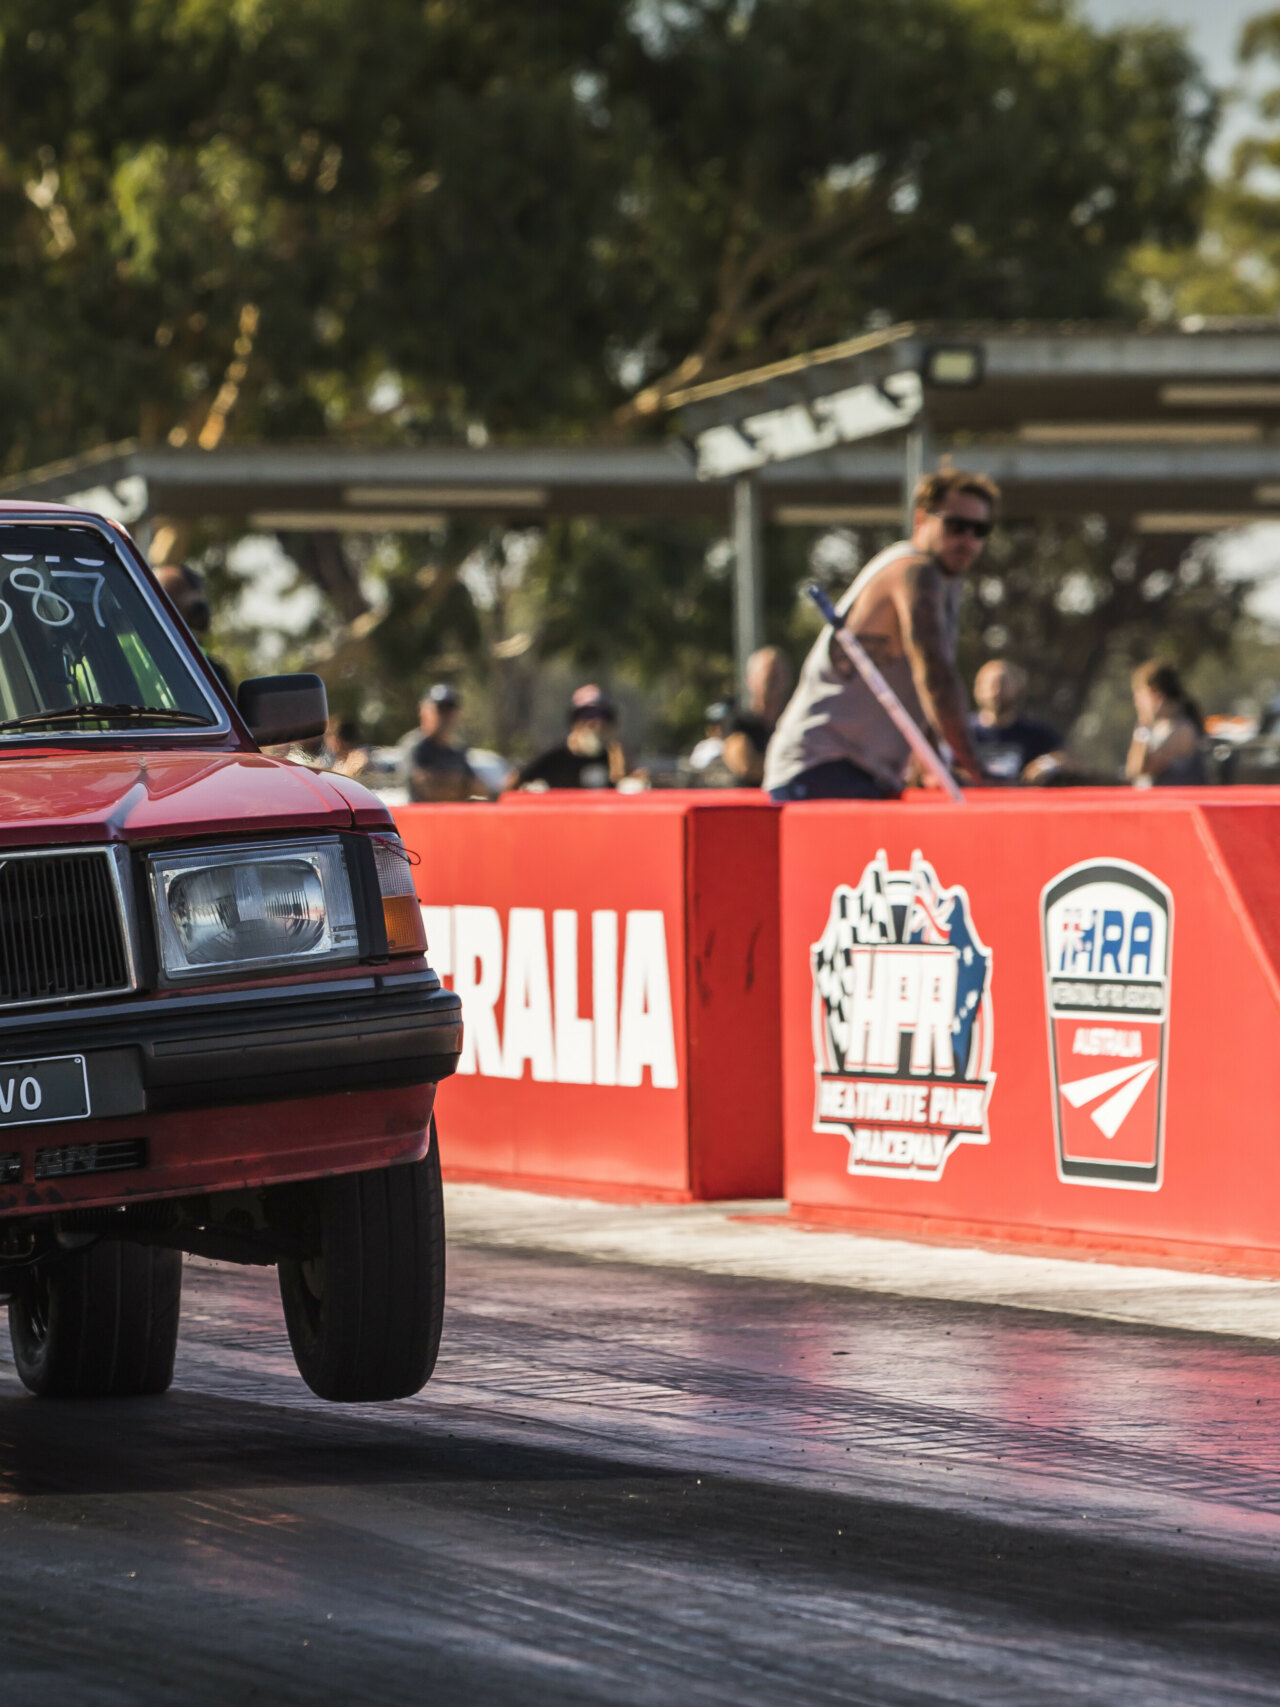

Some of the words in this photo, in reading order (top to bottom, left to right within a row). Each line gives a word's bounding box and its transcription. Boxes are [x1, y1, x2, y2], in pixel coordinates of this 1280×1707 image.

[844, 945, 960, 1077] HPR
[820, 1080, 929, 1123] HEATHCOTE
[929, 1086, 986, 1127] PARK
[853, 1128, 949, 1167] RACEWAY
